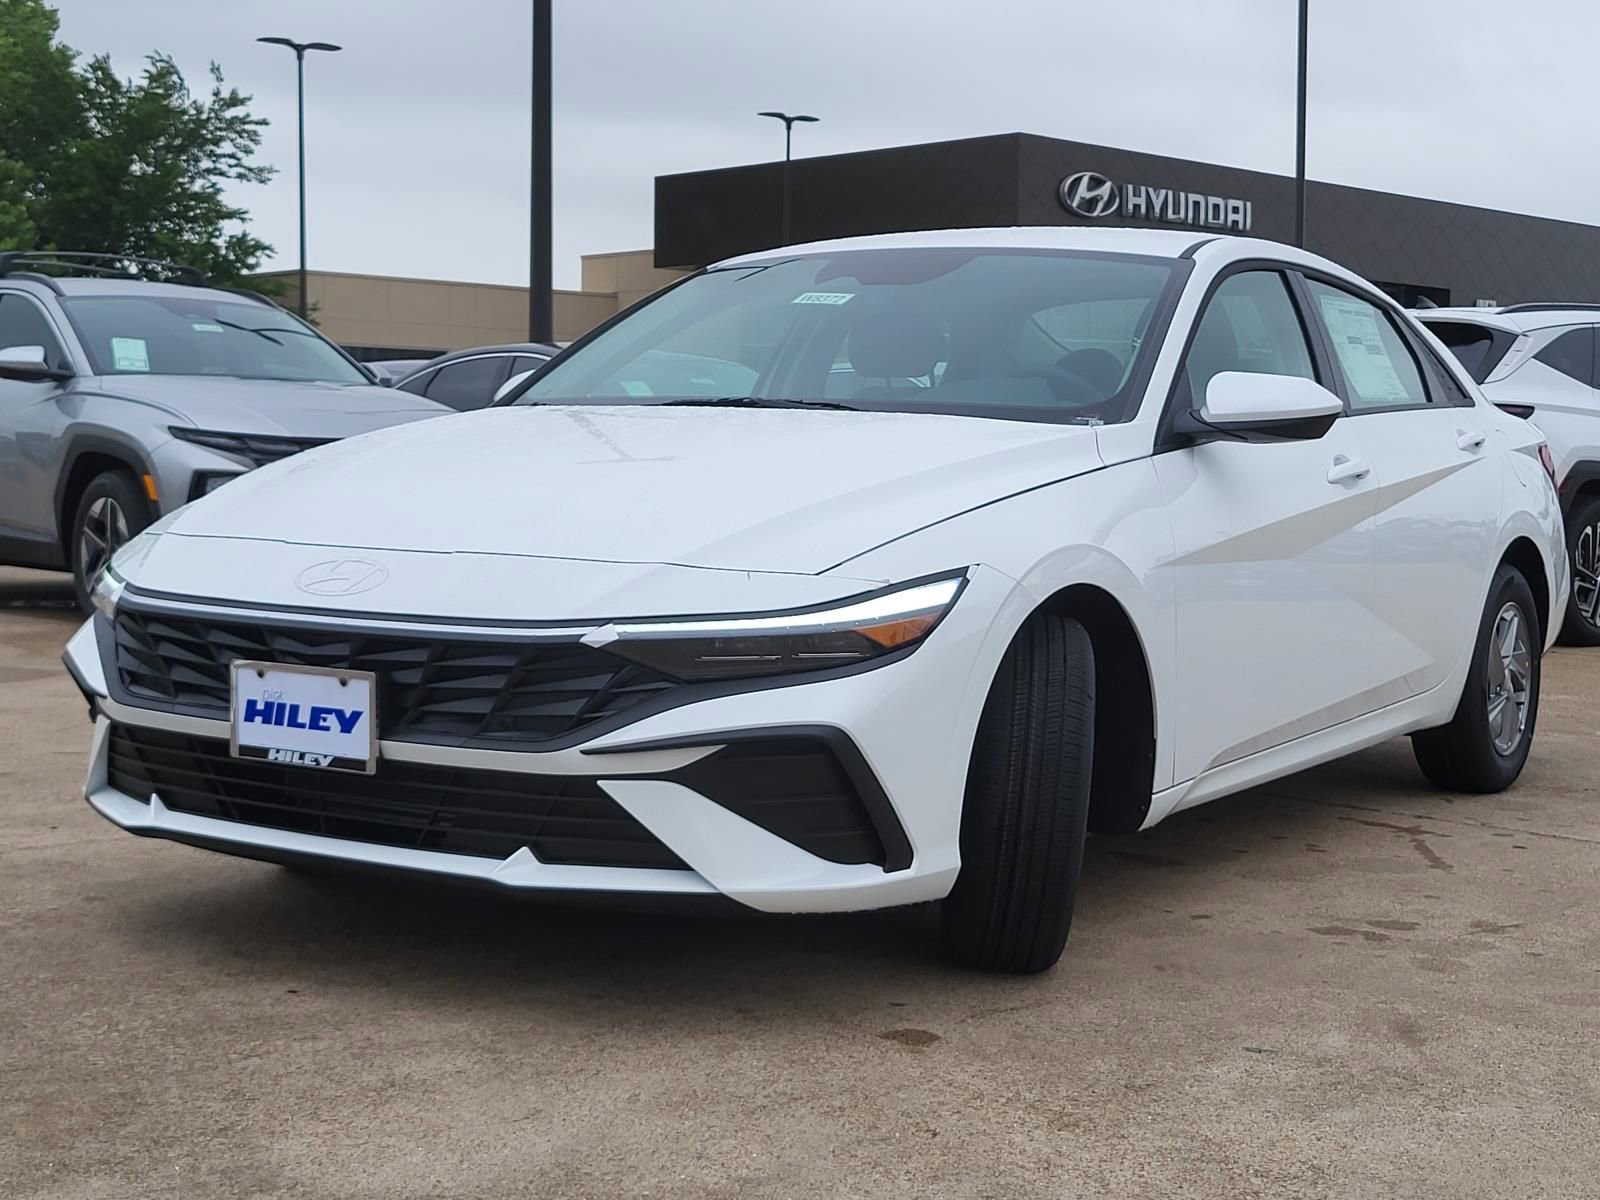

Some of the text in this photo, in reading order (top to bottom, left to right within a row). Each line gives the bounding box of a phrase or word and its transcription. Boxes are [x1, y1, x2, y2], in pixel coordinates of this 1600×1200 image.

[1124, 184, 1252, 231] HYUNDAI
[244, 698, 364, 734] HILEY
[267, 748, 335, 767] HILEY
